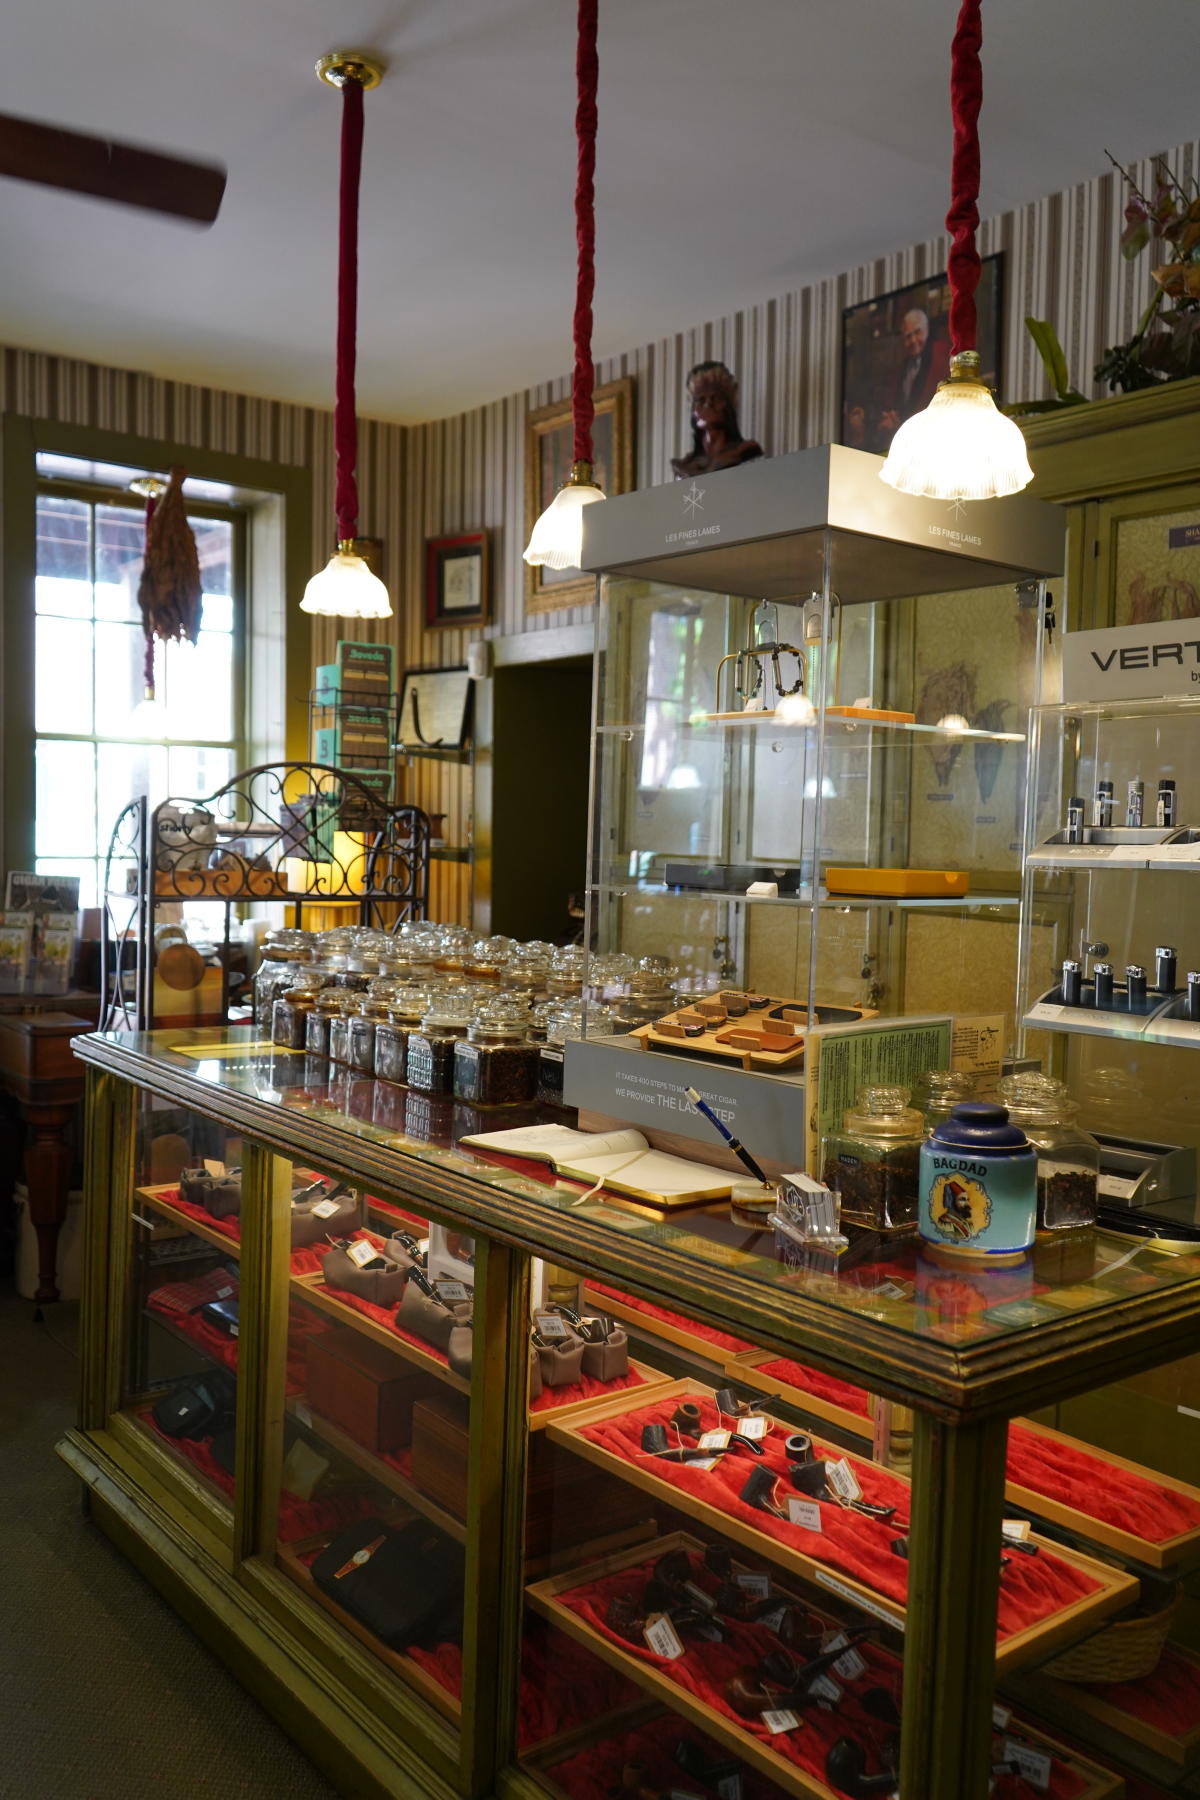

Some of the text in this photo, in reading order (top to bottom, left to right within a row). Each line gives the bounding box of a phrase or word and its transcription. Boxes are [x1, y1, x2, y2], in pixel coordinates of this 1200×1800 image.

[665, 532, 677, 543] LES
[678, 529, 697, 541] FINES
[698, 525, 721, 537] LAMES
[928, 525, 942, 536] LES
[961, 533, 982, 546] LAMES
[621, 1073, 639, 1083] TAKES
[650, 1078, 667, 1090] STEPS
[668, 1083, 676, 1092] TO
[698, 1090, 718, 1102] GREAT
[615, 1087, 626, 1097] WE
[626, 1089, 655, 1105] PROVIDE
[657, 1094, 676, 1110] THE
[678, 1099, 702, 1117] LAS
[932, 1157, 988, 1177] BAGDAD
